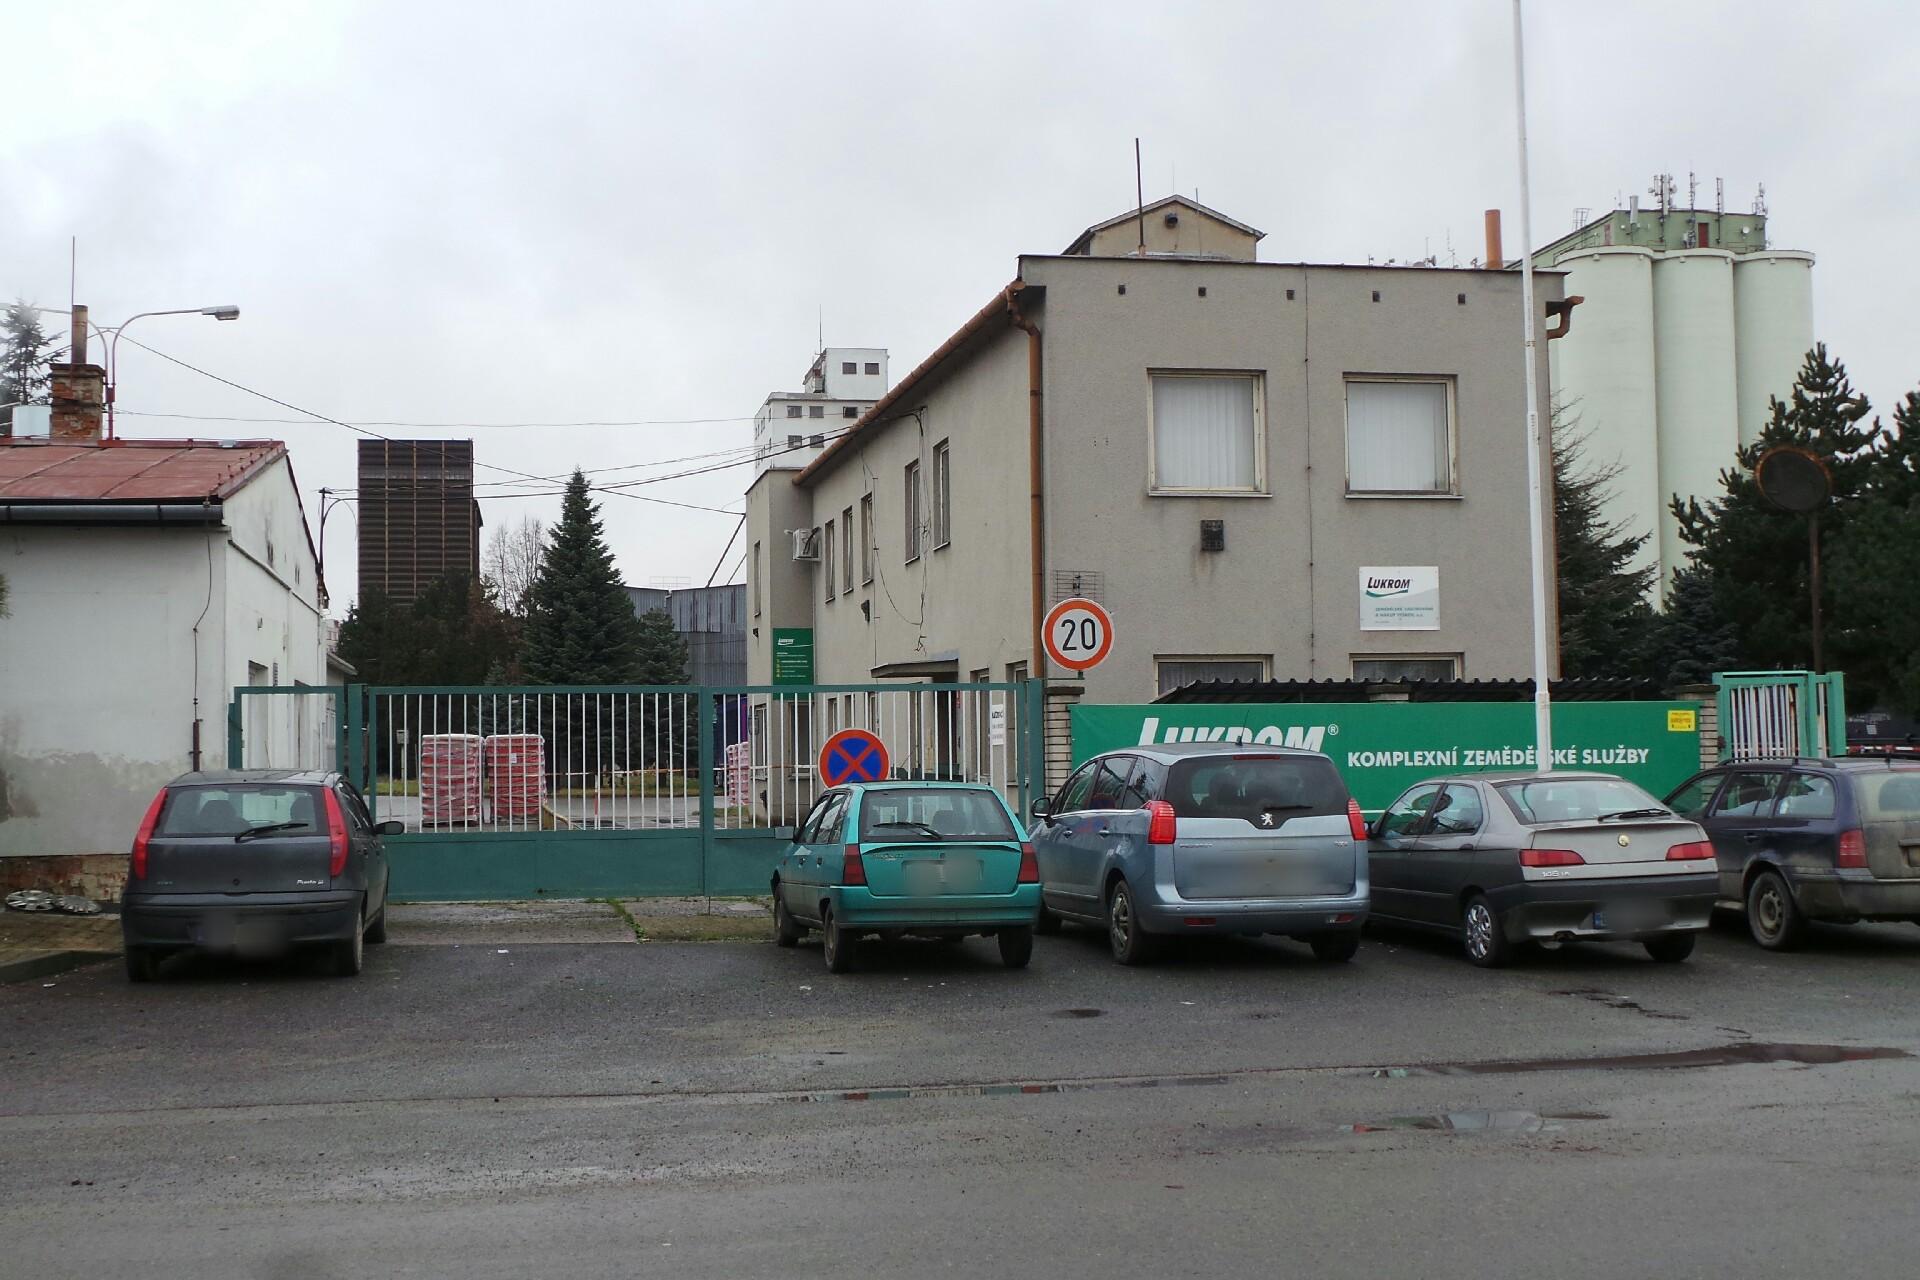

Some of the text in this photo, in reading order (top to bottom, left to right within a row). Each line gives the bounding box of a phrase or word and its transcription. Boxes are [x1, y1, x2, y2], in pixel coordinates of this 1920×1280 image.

[1367, 577, 1411, 589] LUKROM
[1061, 618, 1096, 651] 20
[1347, 744, 1649, 767] KOMPLEXNÍ ZEMĚDĚSKÉ SLUŽBY
